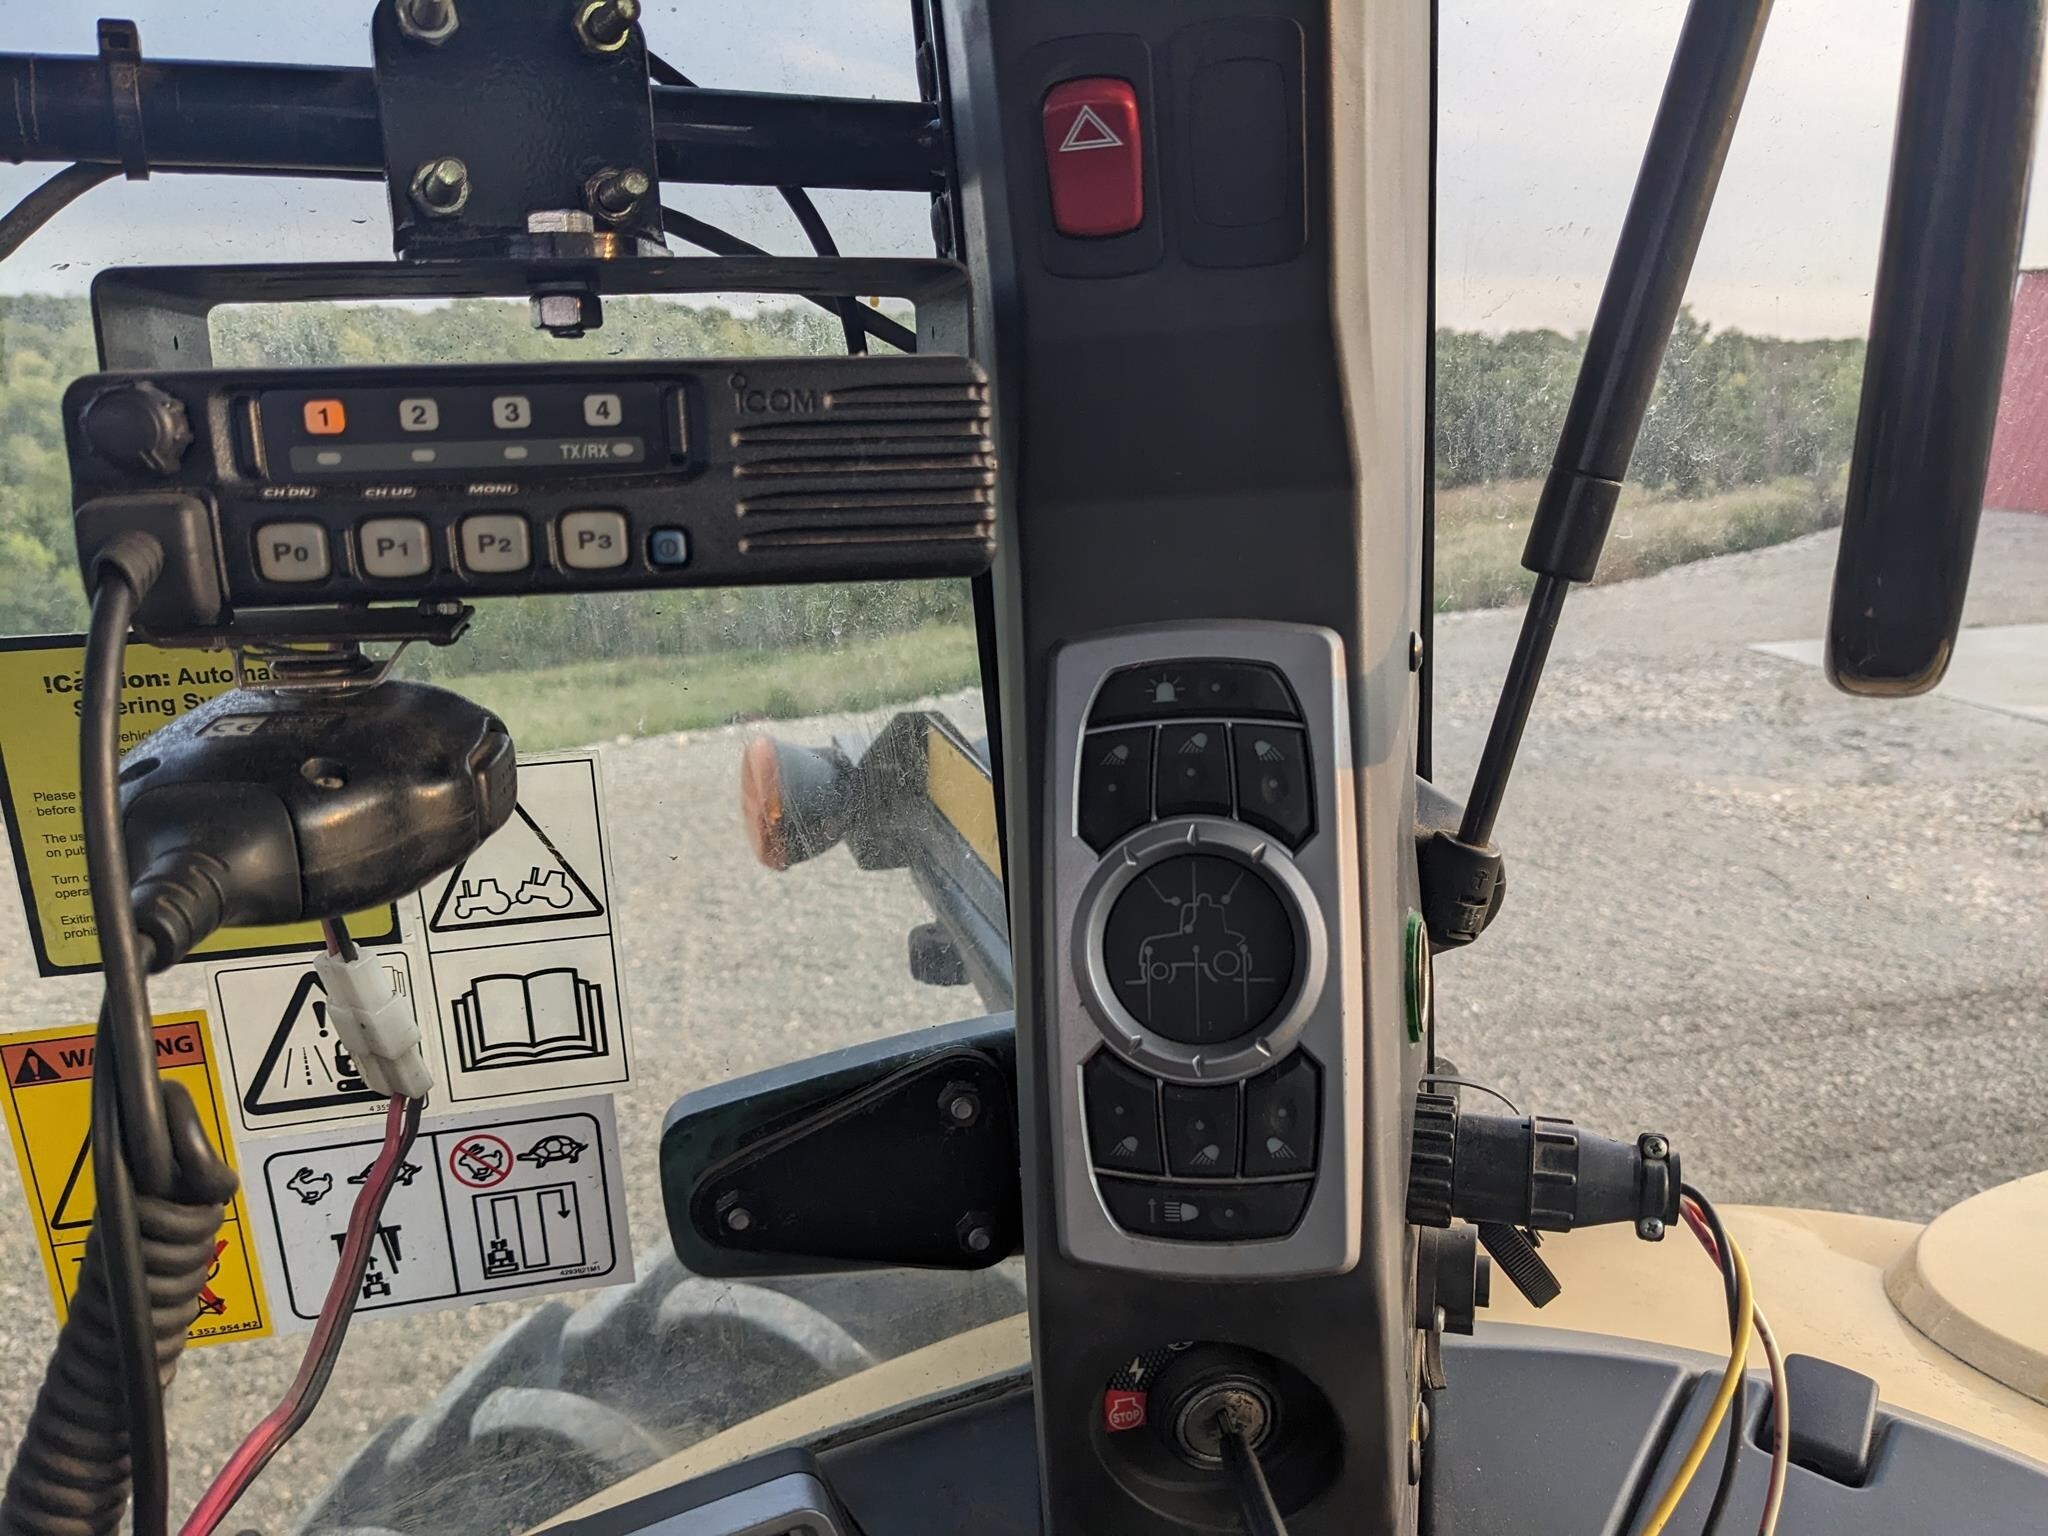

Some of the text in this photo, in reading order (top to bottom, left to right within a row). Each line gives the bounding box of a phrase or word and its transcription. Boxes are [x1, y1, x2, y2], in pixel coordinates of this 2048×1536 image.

[411, 405, 427, 425] 2
[505, 402, 520, 423] 3
[596, 400, 611, 420] 4
[317, 408, 329, 426] 1
[560, 443, 609, 460] TX/RX
[263, 488, 286, 497] CH
[364, 487, 413, 497] CH UP
[468, 485, 512, 495] MONI
[477, 533, 512, 554] P2
[578, 529, 613, 550] P3
[376, 538, 409, 558] P1
[33, 791, 76, 802] Please
[36, 805, 76, 816] before
[42, 832, 67, 844] The
[46, 850, 61, 858] on
[51, 874, 80, 885] Turn
[60, 914, 94, 926] Exitin
[1112, 1410, 1140, 1423] STOP
